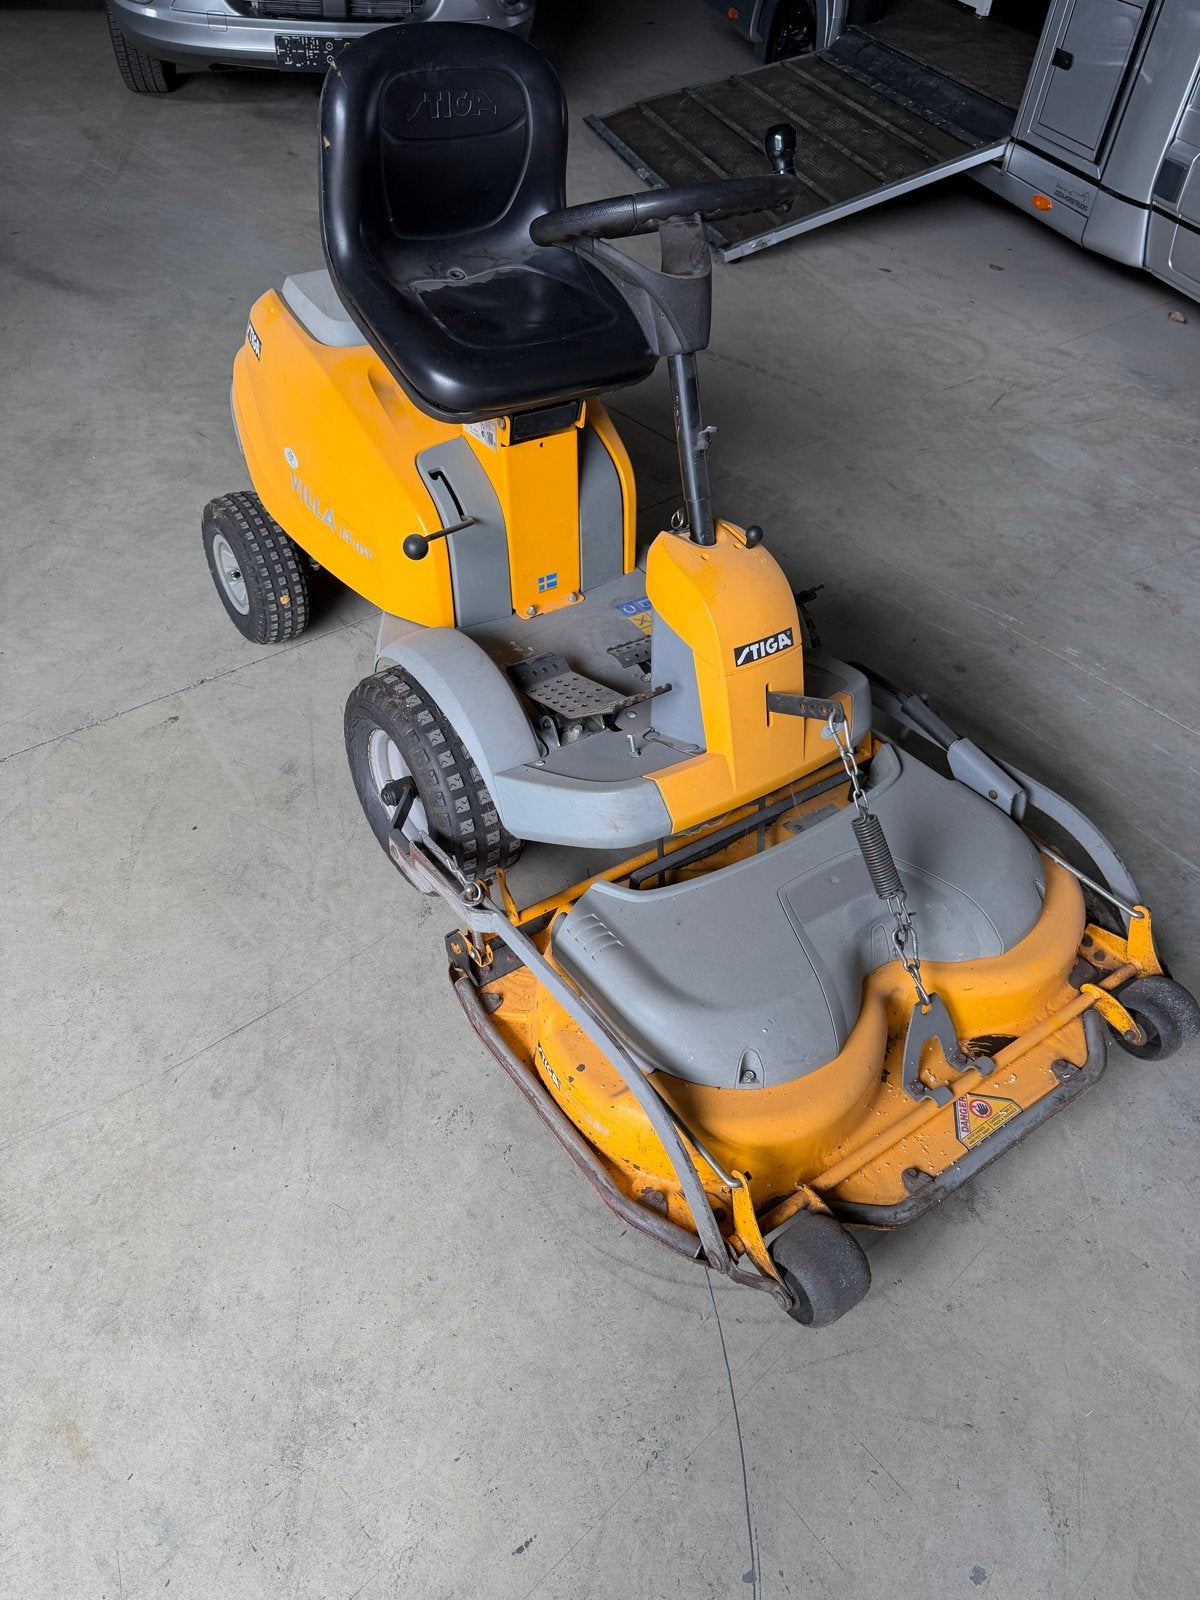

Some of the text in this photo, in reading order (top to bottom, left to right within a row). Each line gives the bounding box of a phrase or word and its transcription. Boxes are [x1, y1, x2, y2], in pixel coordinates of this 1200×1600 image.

[406, 88, 497, 122] STIGA
[291, 471, 336, 532] VILLA
[340, 526, 352, 545] 14
[736, 632, 792, 666] STIGA
[958, 1096, 969, 1133] DANGER
